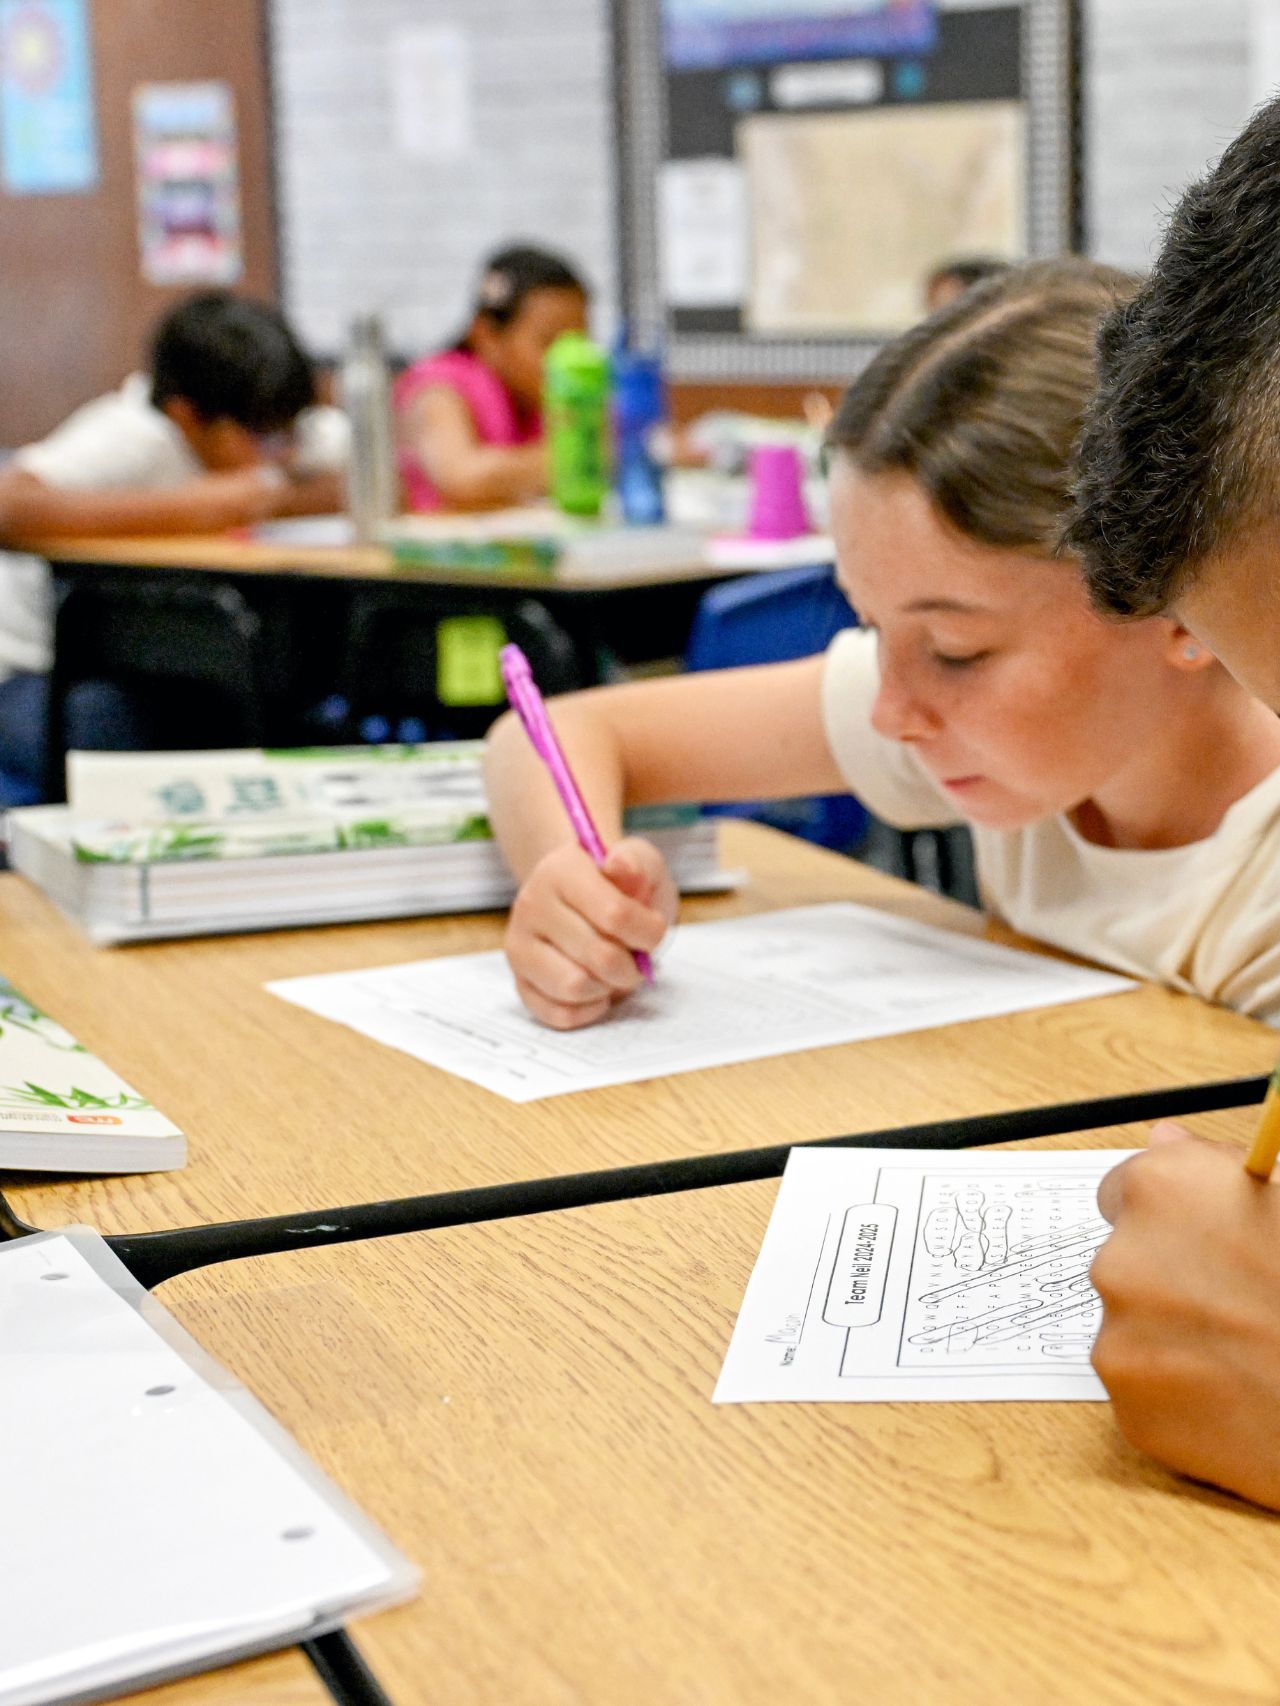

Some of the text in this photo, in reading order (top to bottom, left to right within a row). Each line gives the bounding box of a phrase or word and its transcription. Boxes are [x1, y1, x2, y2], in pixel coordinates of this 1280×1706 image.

[845, 1223, 879, 1305] Team Neil 2024-2025
